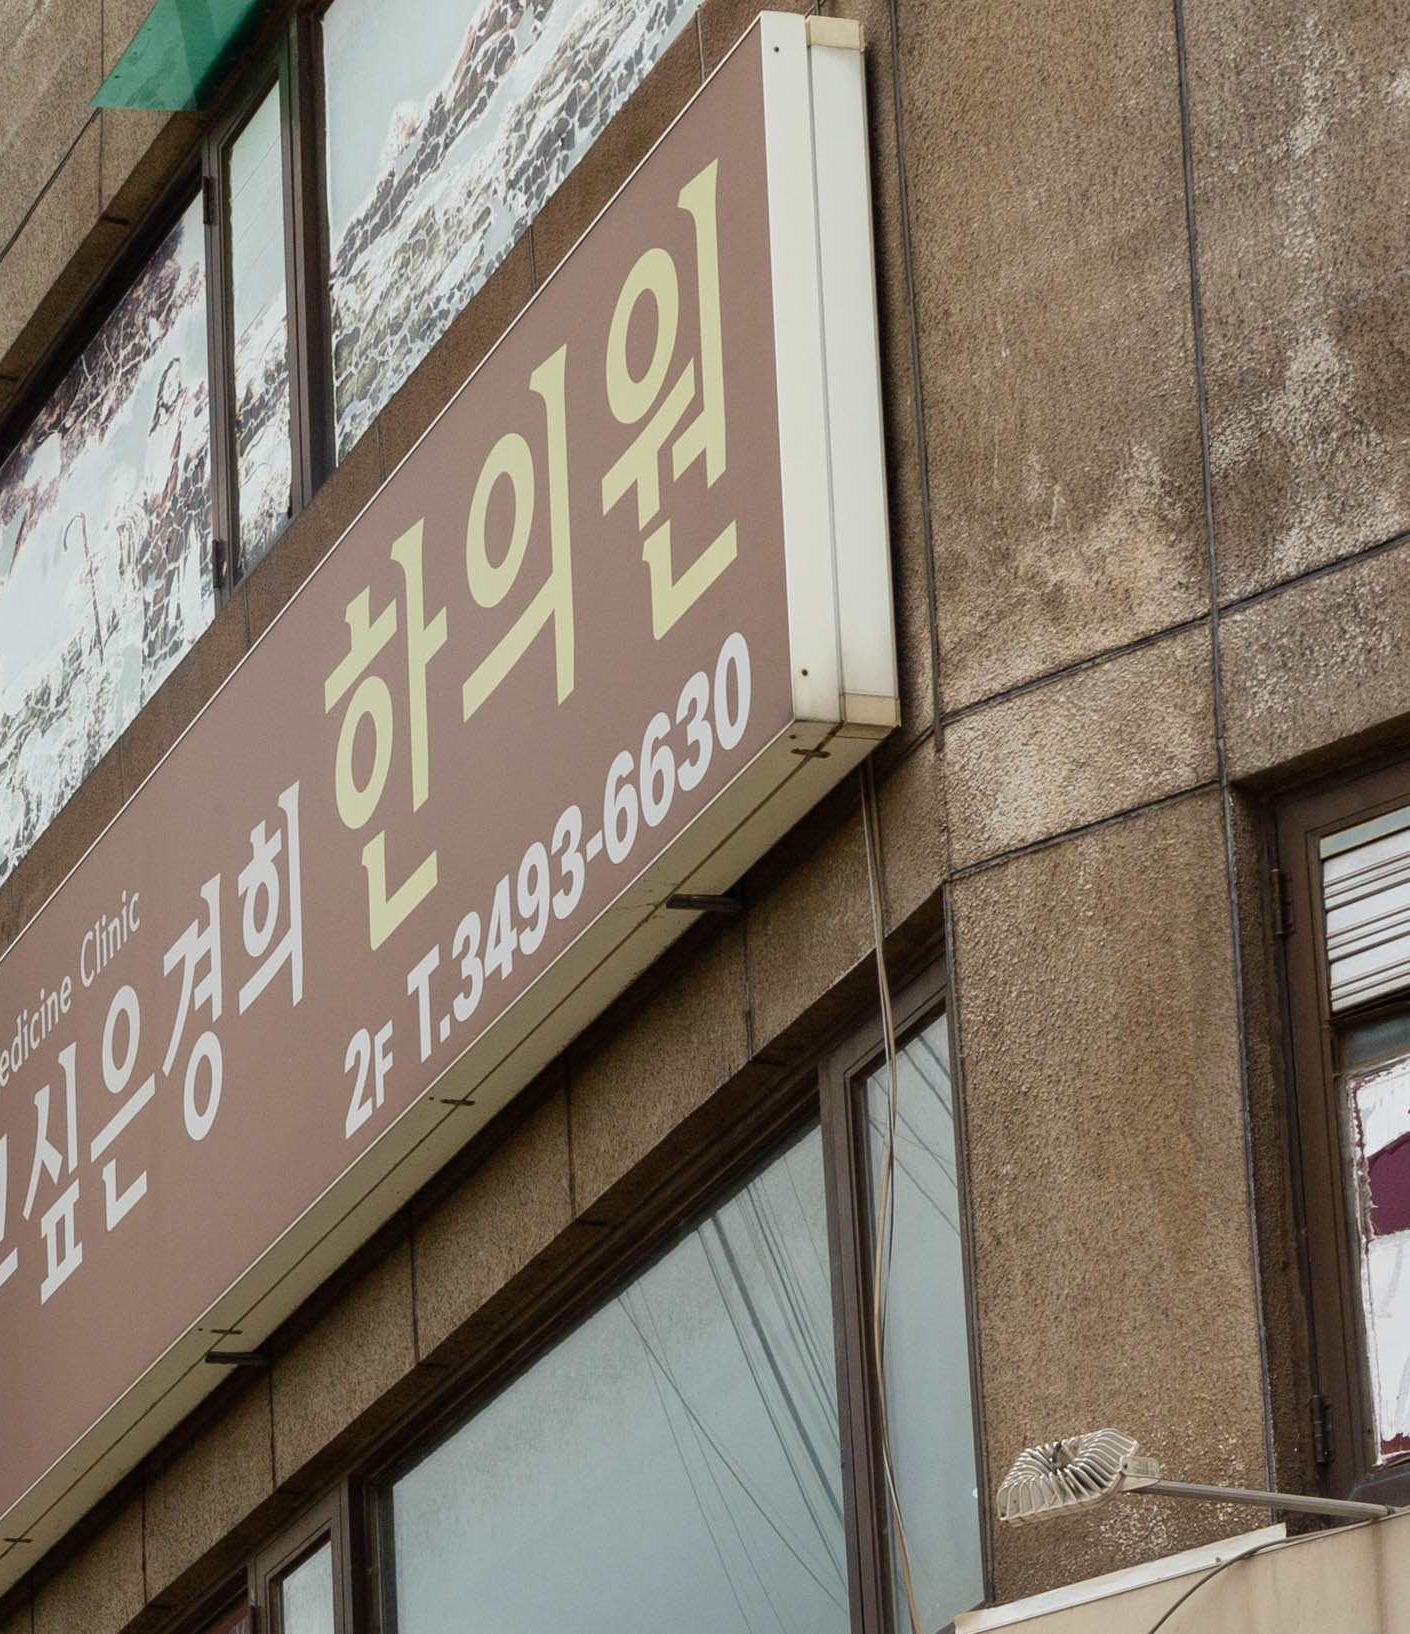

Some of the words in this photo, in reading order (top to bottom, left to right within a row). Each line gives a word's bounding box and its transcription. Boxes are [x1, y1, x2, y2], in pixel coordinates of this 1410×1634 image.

[325, 157, 739, 952] 한의원
[79, 889, 141, 990] Clinic
[343, 1021, 393, 1140] 2F
